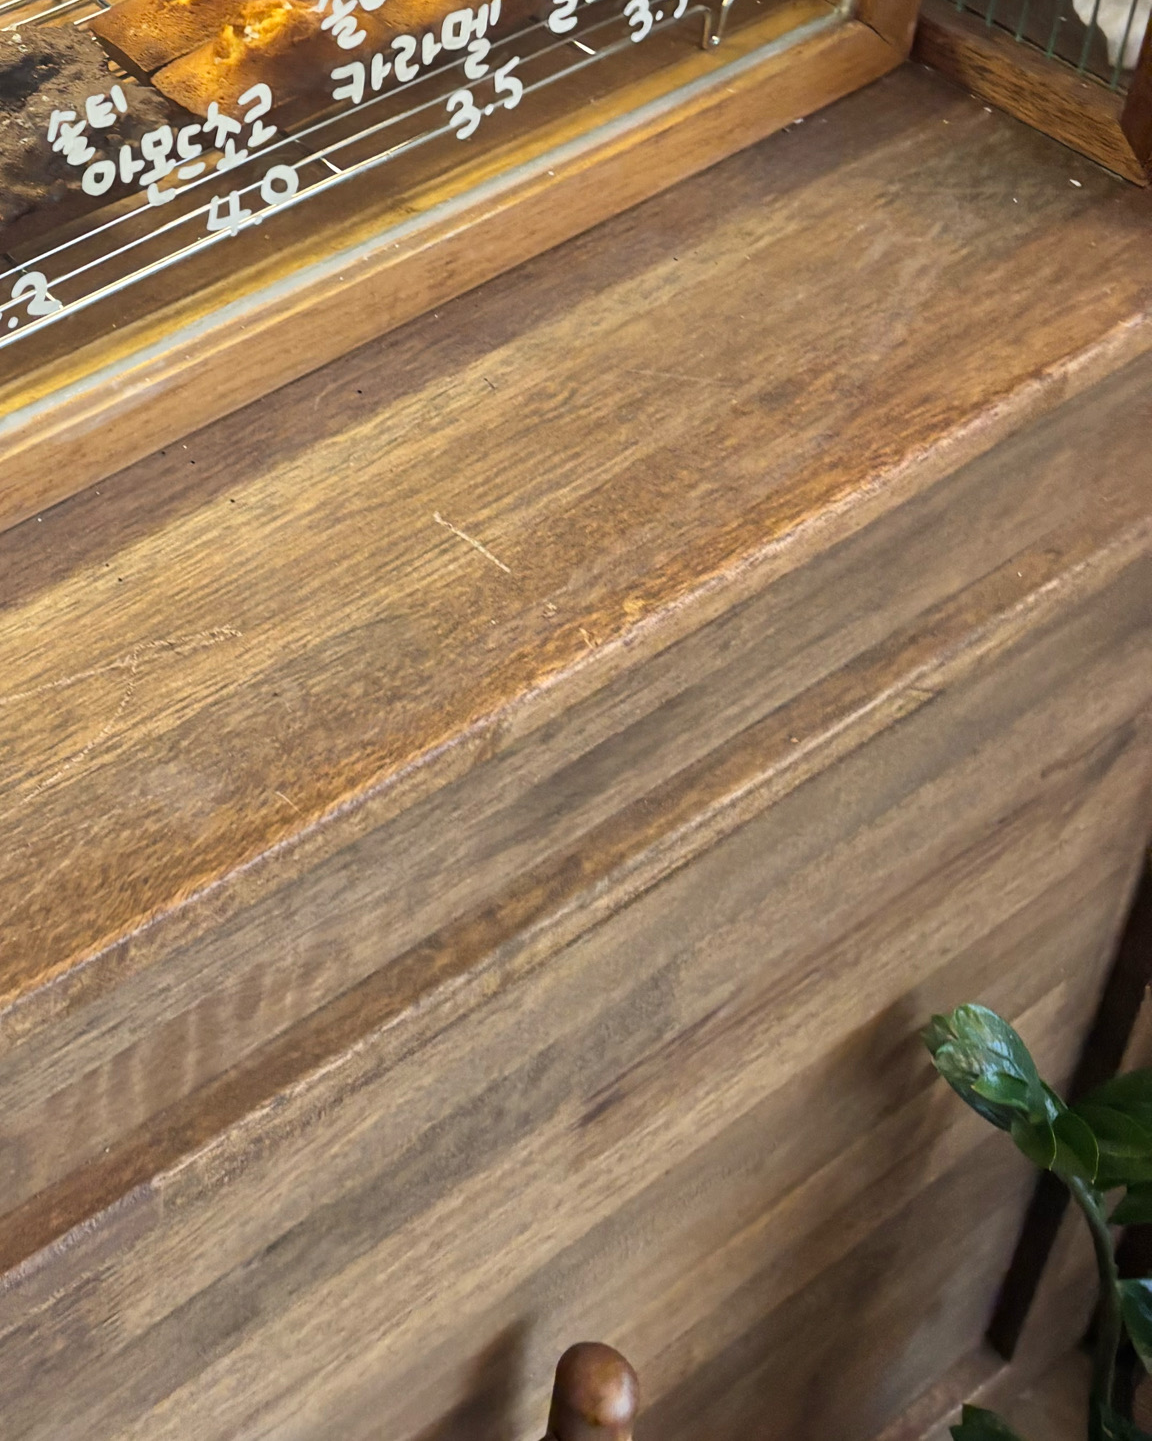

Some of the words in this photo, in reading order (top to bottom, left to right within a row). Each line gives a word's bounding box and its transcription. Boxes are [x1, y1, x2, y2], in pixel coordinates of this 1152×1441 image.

[47, 84, 128, 166] 솔티
[446, 55, 523, 140] 3.5
[206, 164, 300, 237] 4.0
